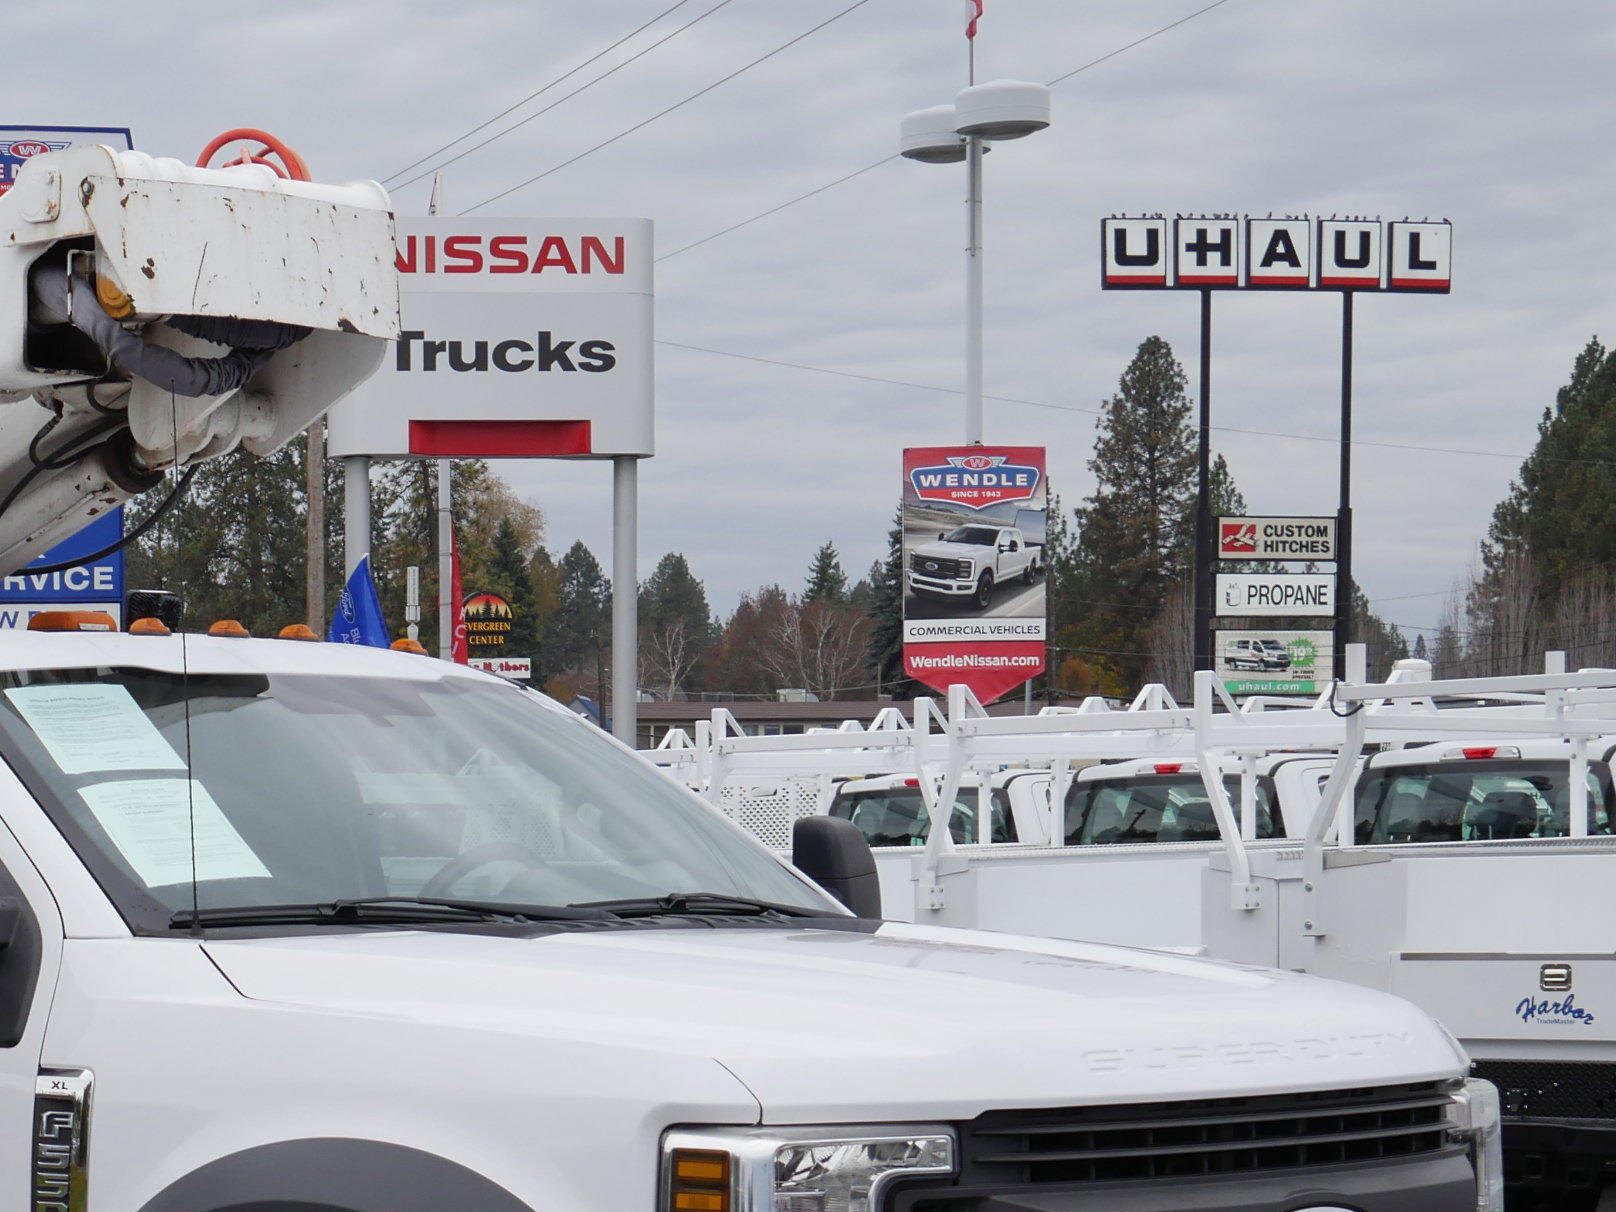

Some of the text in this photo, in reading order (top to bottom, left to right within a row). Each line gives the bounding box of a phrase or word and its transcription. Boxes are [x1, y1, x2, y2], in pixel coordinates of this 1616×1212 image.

[396, 236, 624, 274] NISSAN
[396, 331, 616, 372] Trucks
[919, 474, 1028, 487] WENDLE
[1264, 525, 1328, 538] CUSTOM
[1263, 541, 1330, 554] HITCHES
[1248, 584, 1328, 605] PROPANE
[909, 625, 1041, 637] COMMERCIAL VEHICLES
[469, 635, 505, 645] CENTER
[910, 654, 1040, 668] WendleNissan.com
[1238, 682, 1300, 691] uhaul.com
[1515, 993, 1594, 1025] Harbor
[51, 1081, 69, 1090] XL
